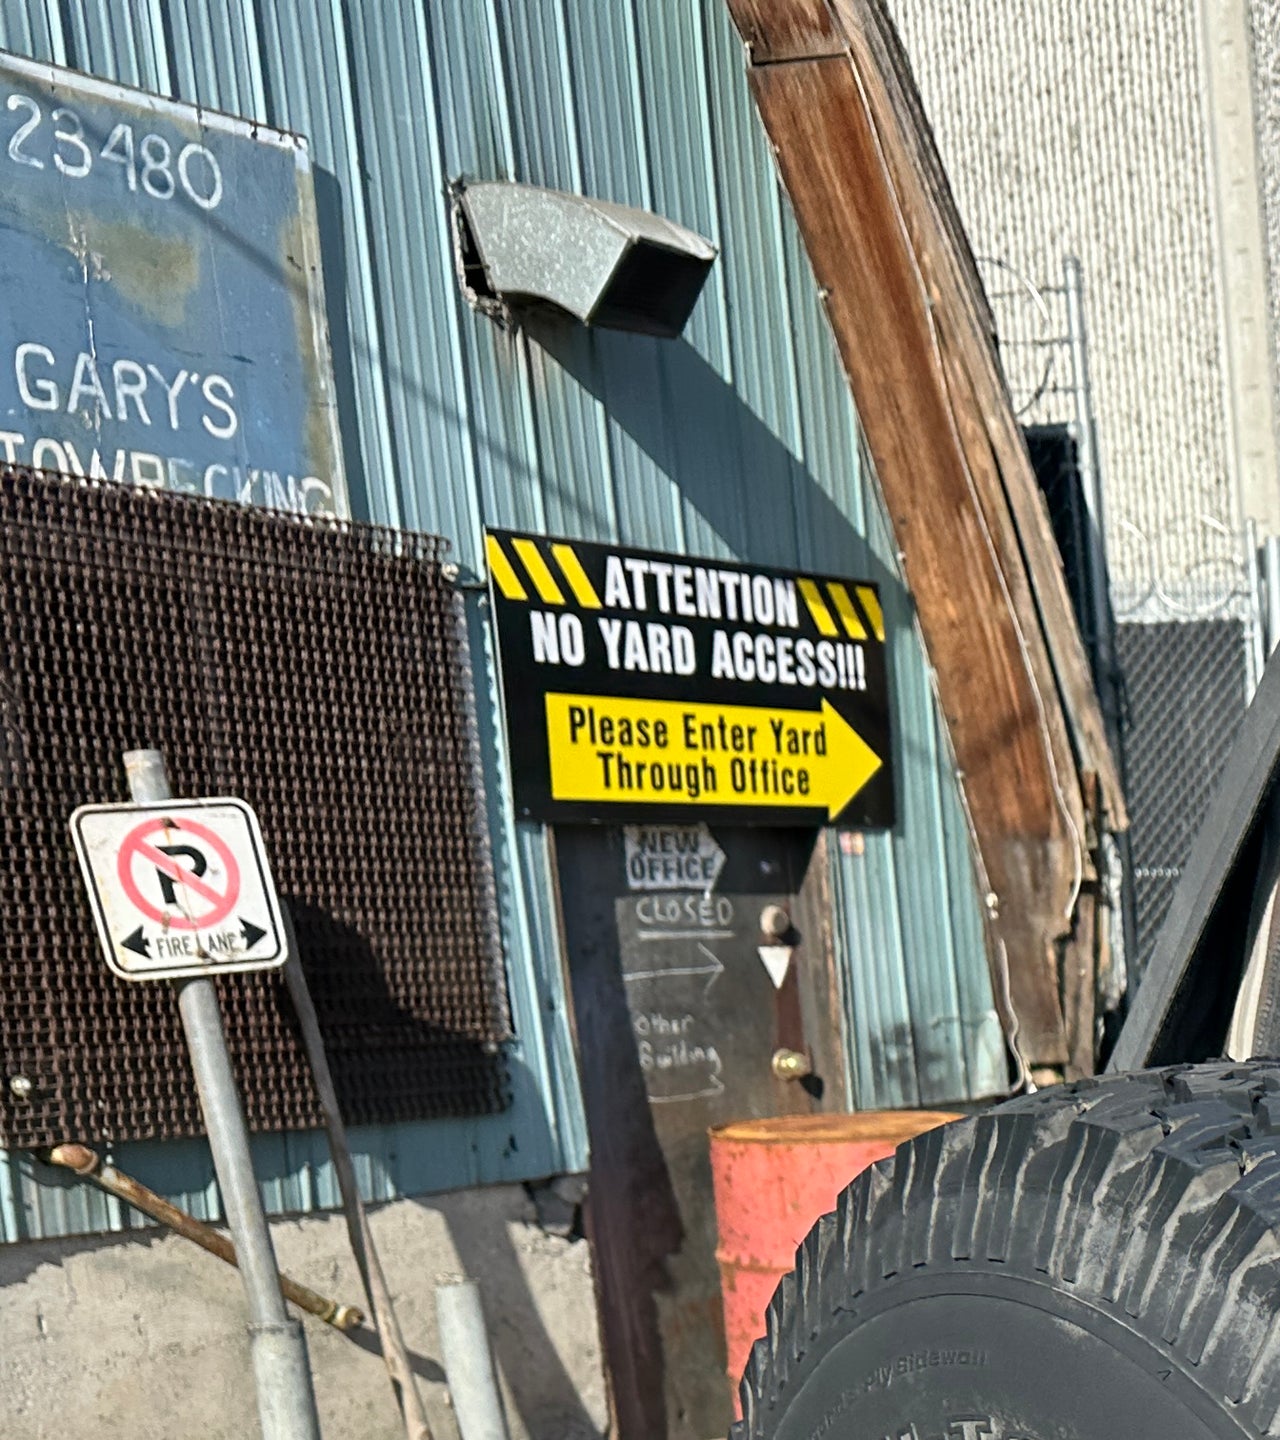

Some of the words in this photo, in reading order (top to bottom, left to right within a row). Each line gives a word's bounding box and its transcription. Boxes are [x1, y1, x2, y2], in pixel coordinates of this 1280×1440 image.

[7, 93, 224, 210] 23480
[14, 342, 238, 440] GARY'S
[605, 555, 799, 629] ATTENTION
[529, 610, 585, 666] NO
[598, 617, 697, 676] YARD
[711, 629, 868, 691] ACCESS!!!
[568, 705, 669, 748] Please
[683, 713, 757, 753] Enter
[769, 717, 828, 757] Yard
[597, 751, 718, 798] Through
[731, 757, 810, 796] Office
[640, 829, 701, 852] NEW
[630, 853, 716, 881] OFFICE
[636, 897, 734, 926] CLOSED
[156, 936, 192, 958] FIRE
